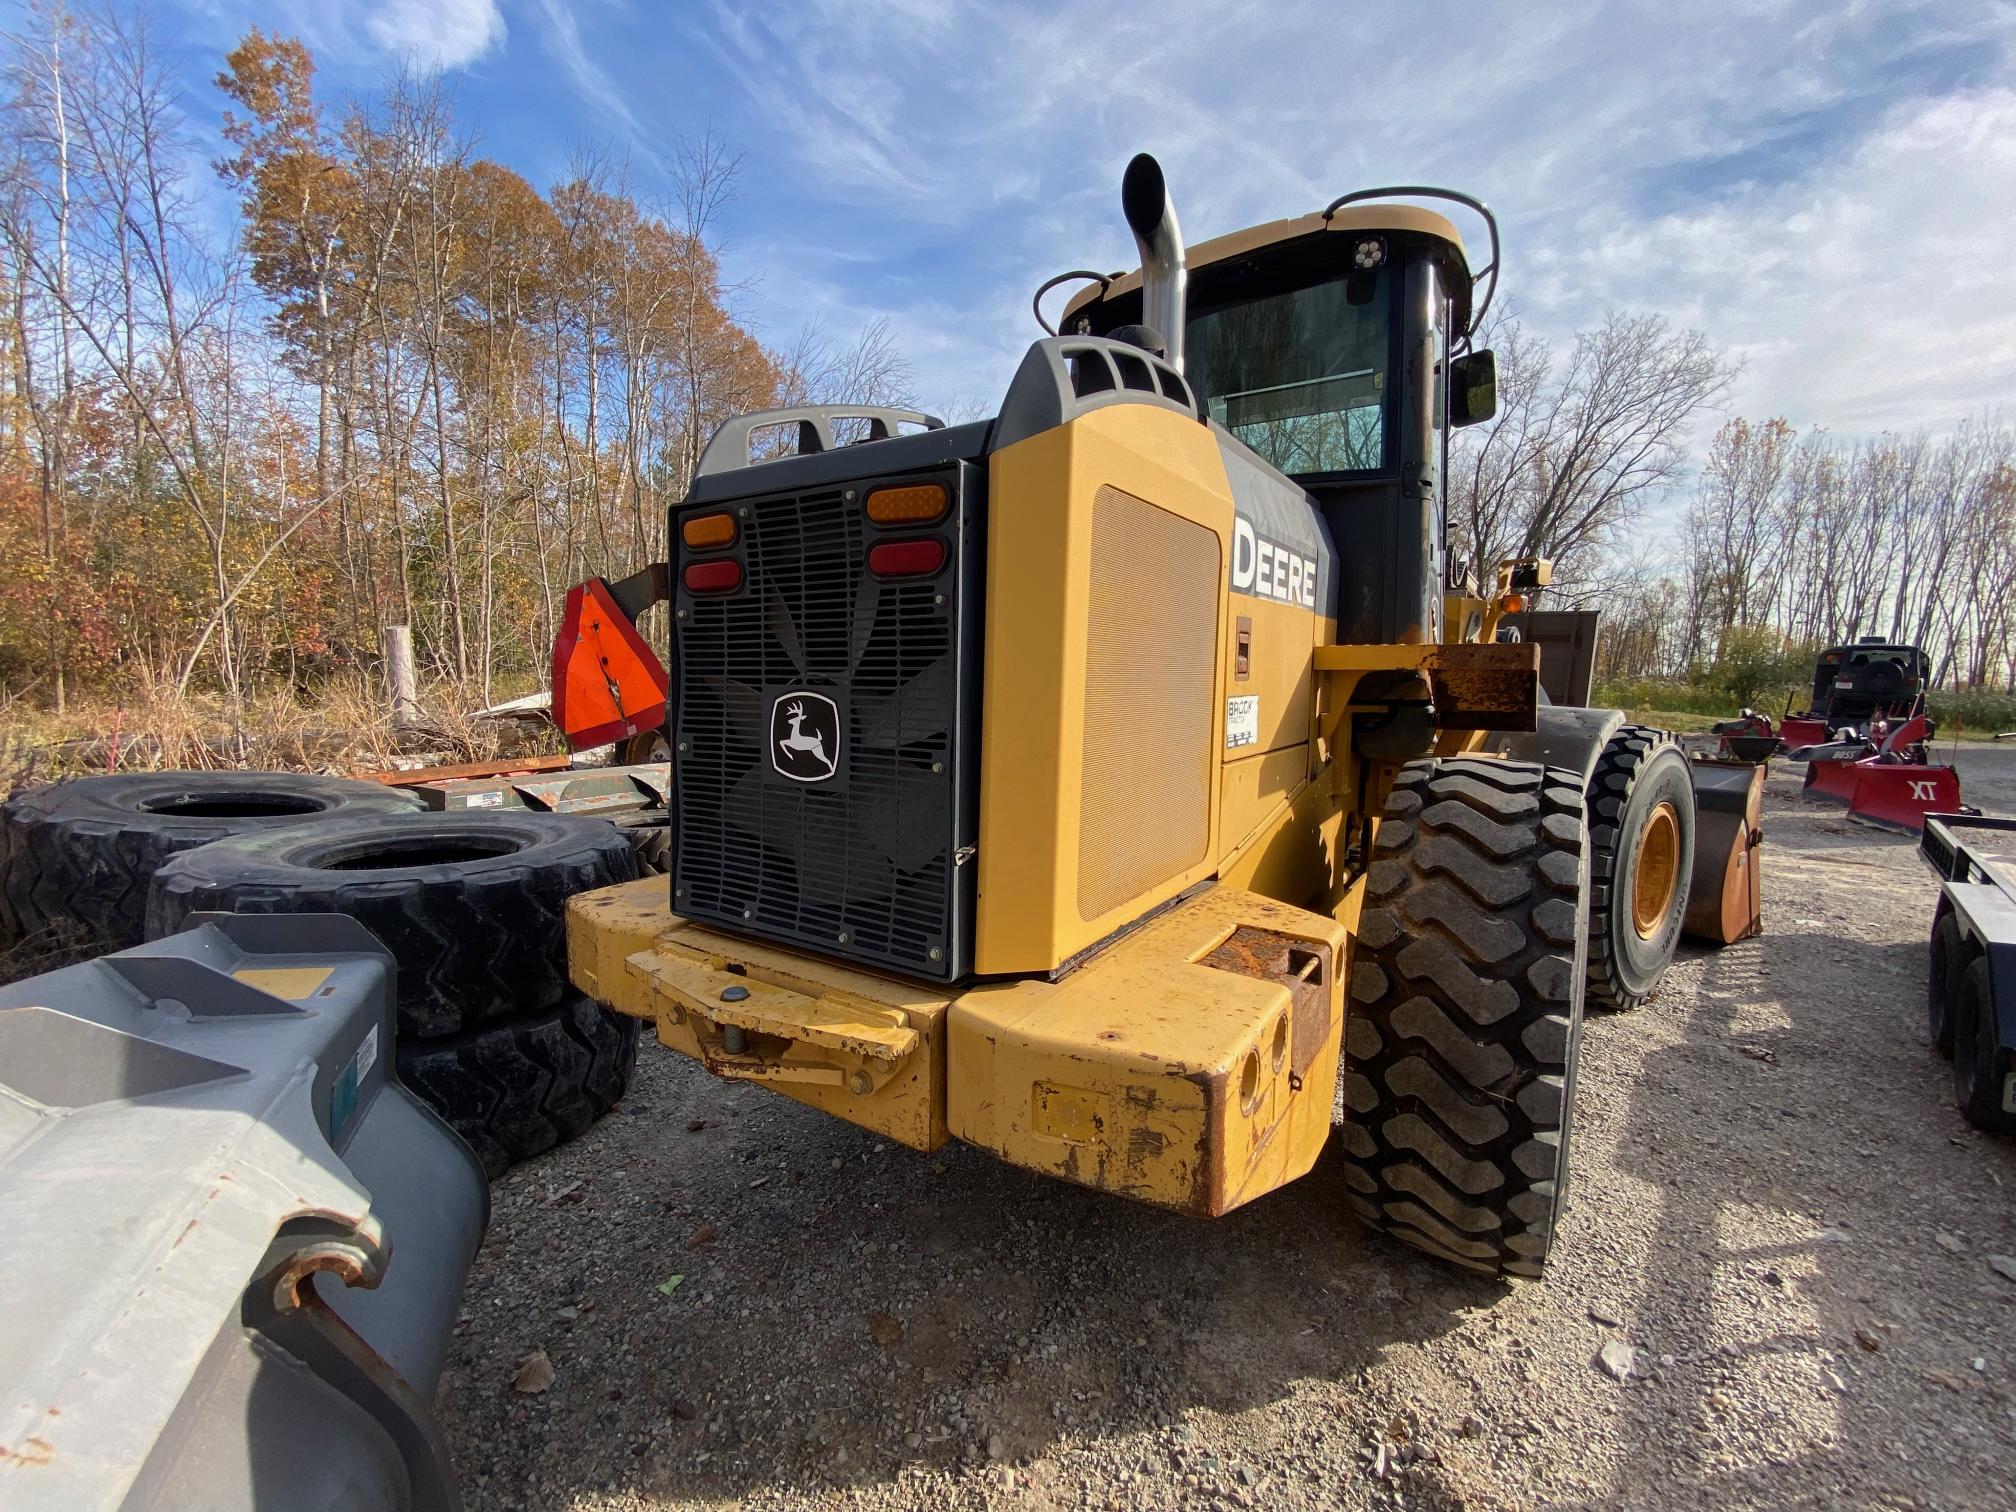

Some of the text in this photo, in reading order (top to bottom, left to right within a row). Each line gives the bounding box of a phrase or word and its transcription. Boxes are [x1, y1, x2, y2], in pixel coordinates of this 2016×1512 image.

[1233, 516, 1316, 607] DEERE
[1832, 751, 1856, 759] BOSS
[1906, 781, 1937, 800] XT
